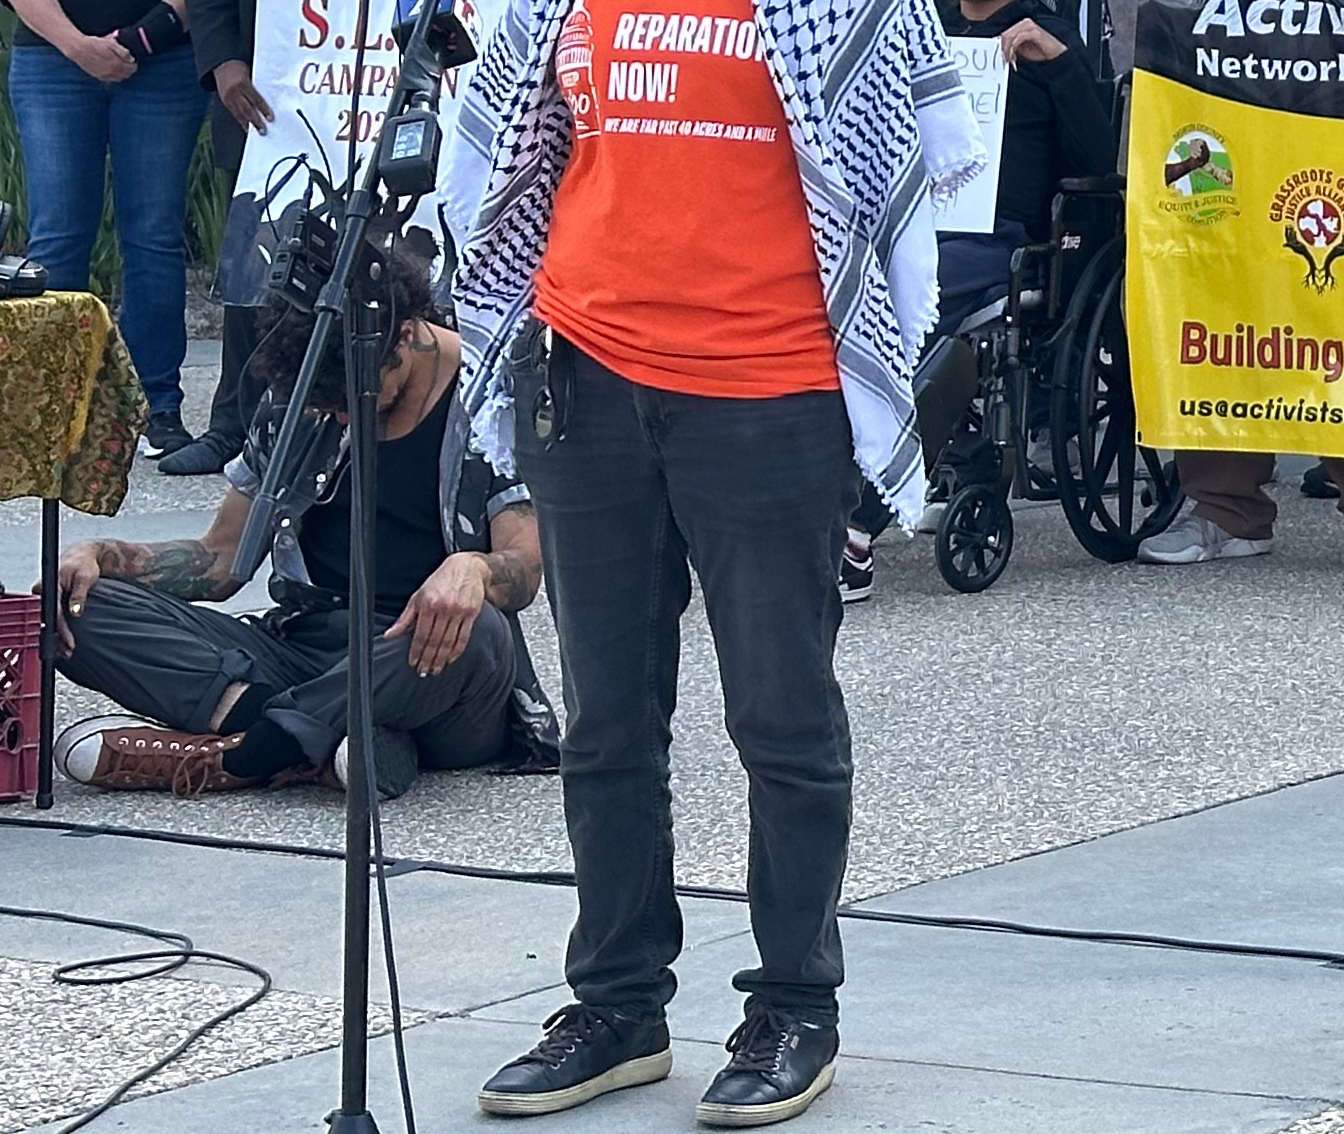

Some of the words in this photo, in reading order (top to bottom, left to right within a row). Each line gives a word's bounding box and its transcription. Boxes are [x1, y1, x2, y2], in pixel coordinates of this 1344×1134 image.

[299, 62, 460, 99] CAMPAN
[608, 61, 679, 104] NOW!
[619, 118, 638, 133] ARE
[679, 120, 691, 135] 40
[692, 121, 723, 138] ACRES
[1179, 321, 1344, 383] Building
